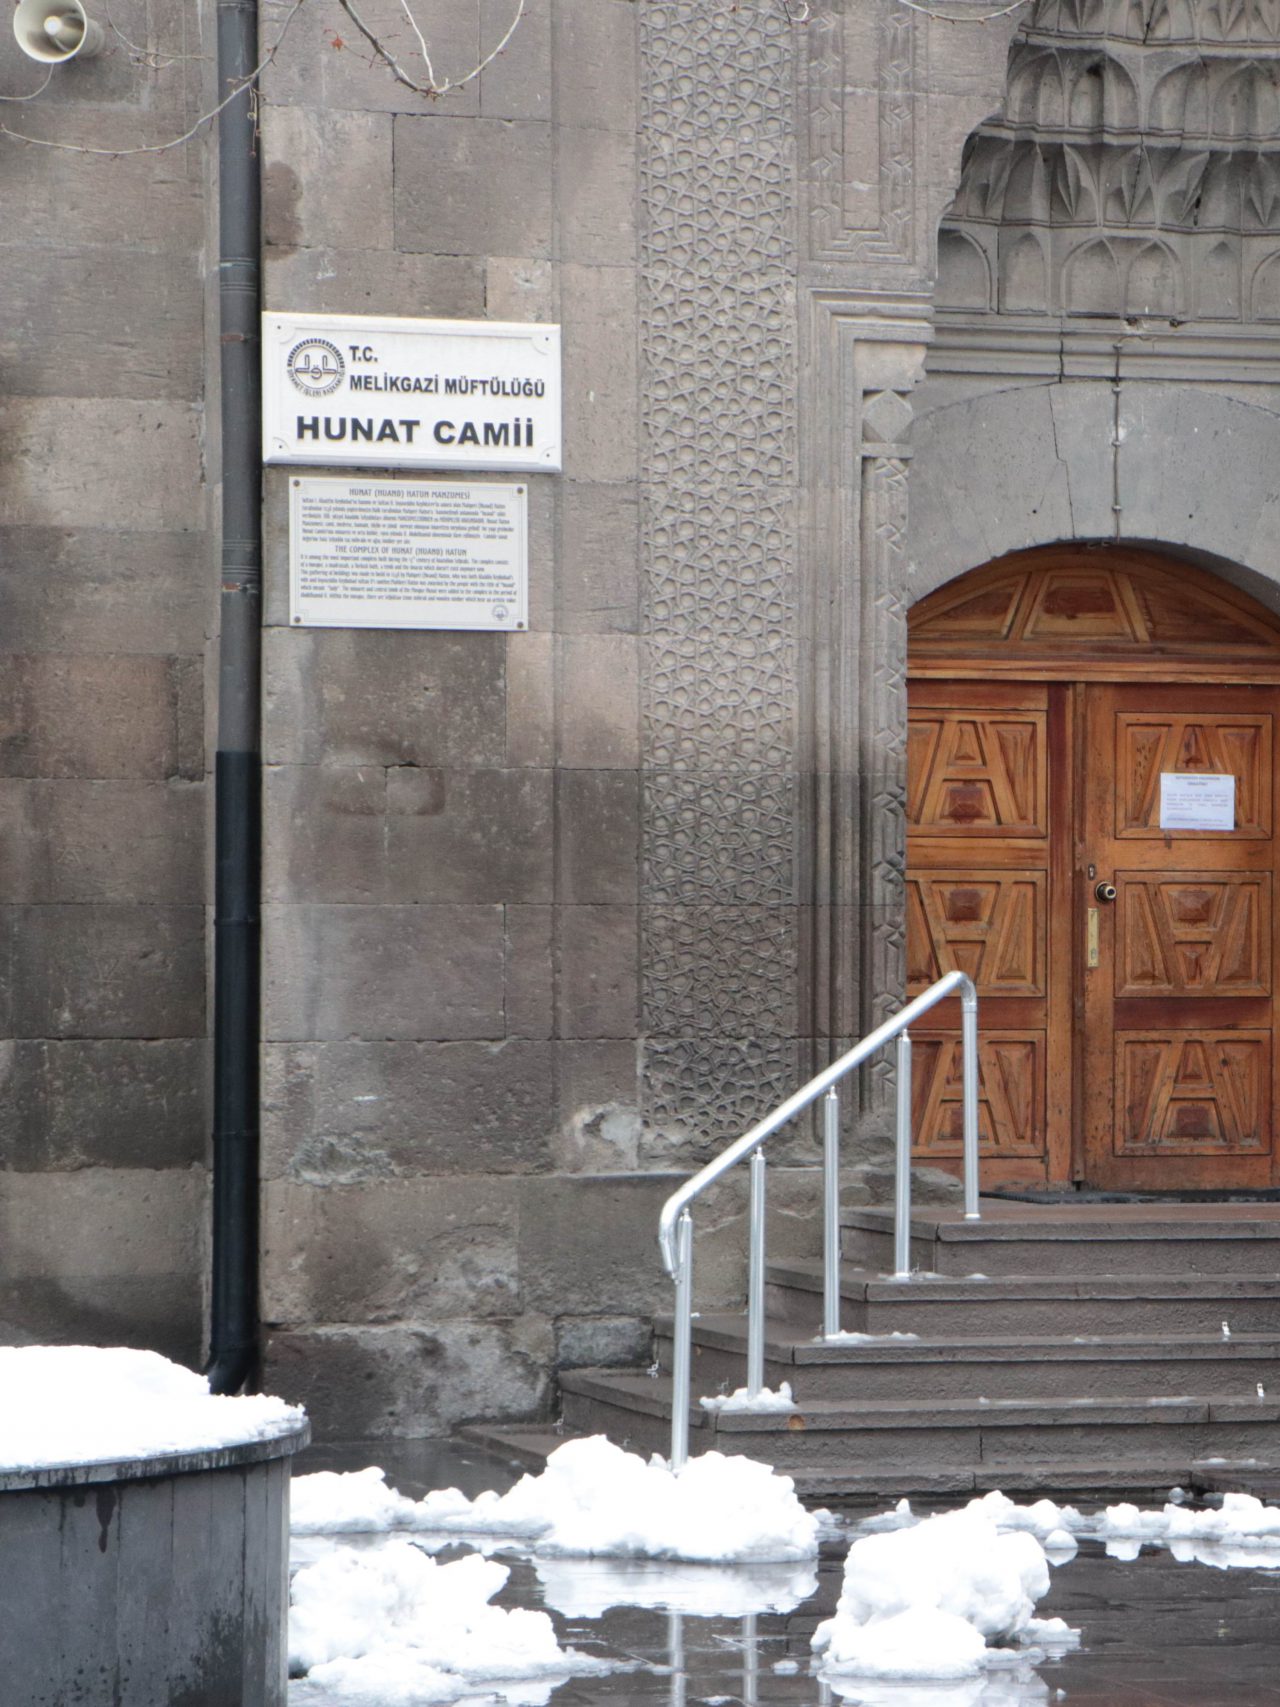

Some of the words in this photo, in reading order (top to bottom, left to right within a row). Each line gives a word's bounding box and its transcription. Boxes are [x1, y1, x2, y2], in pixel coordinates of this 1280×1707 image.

[349, 346, 378, 362] T.C.
[350, 373, 439, 394] MELİKGAZİ
[445, 376, 544, 397] MÜFTÜLÜĞÜ
[296, 416, 419, 443] HUNAT
[434, 418, 534, 447] CAMİİ
[335, 545, 347, 553] THE
[349, 545, 379, 554] COMPLEX
[381, 546, 389, 554] OF
